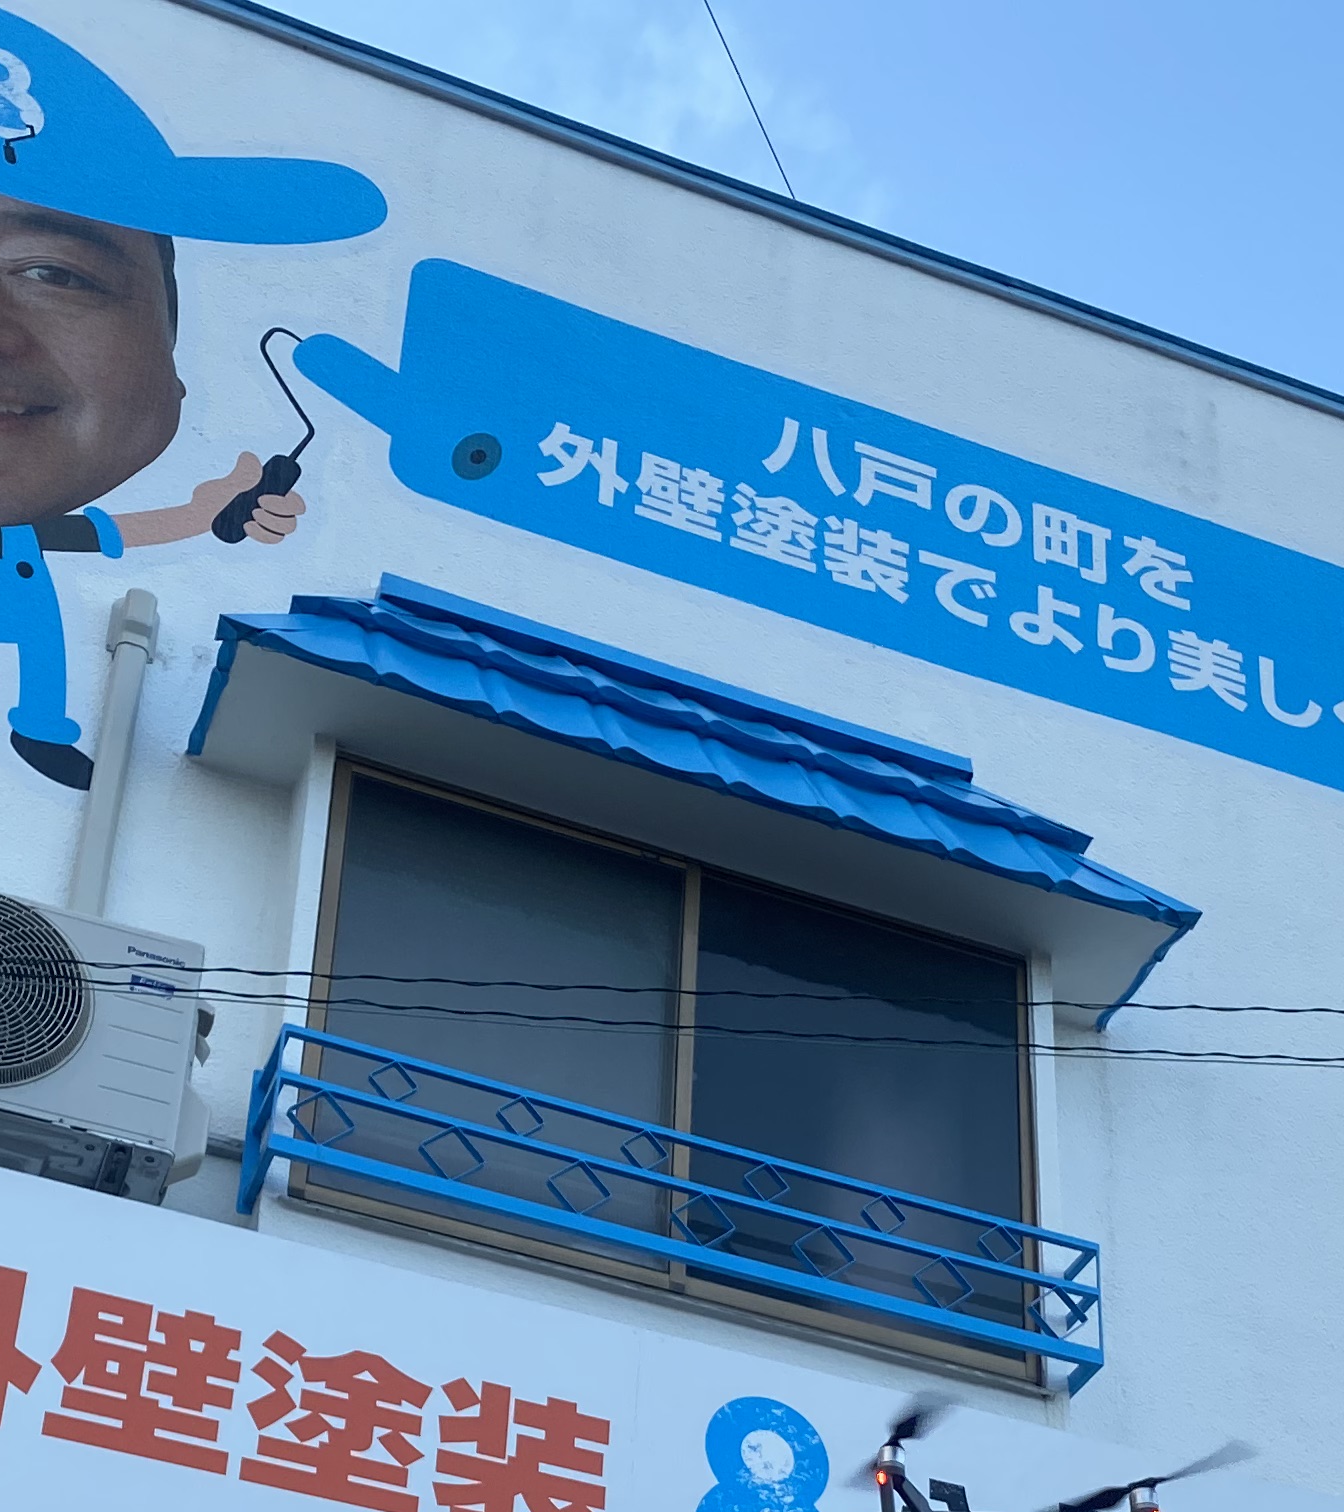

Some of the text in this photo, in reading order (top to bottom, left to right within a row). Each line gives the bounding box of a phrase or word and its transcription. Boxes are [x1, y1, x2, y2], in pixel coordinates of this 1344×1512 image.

[763, 417, 1192, 610] 八戸の町を
